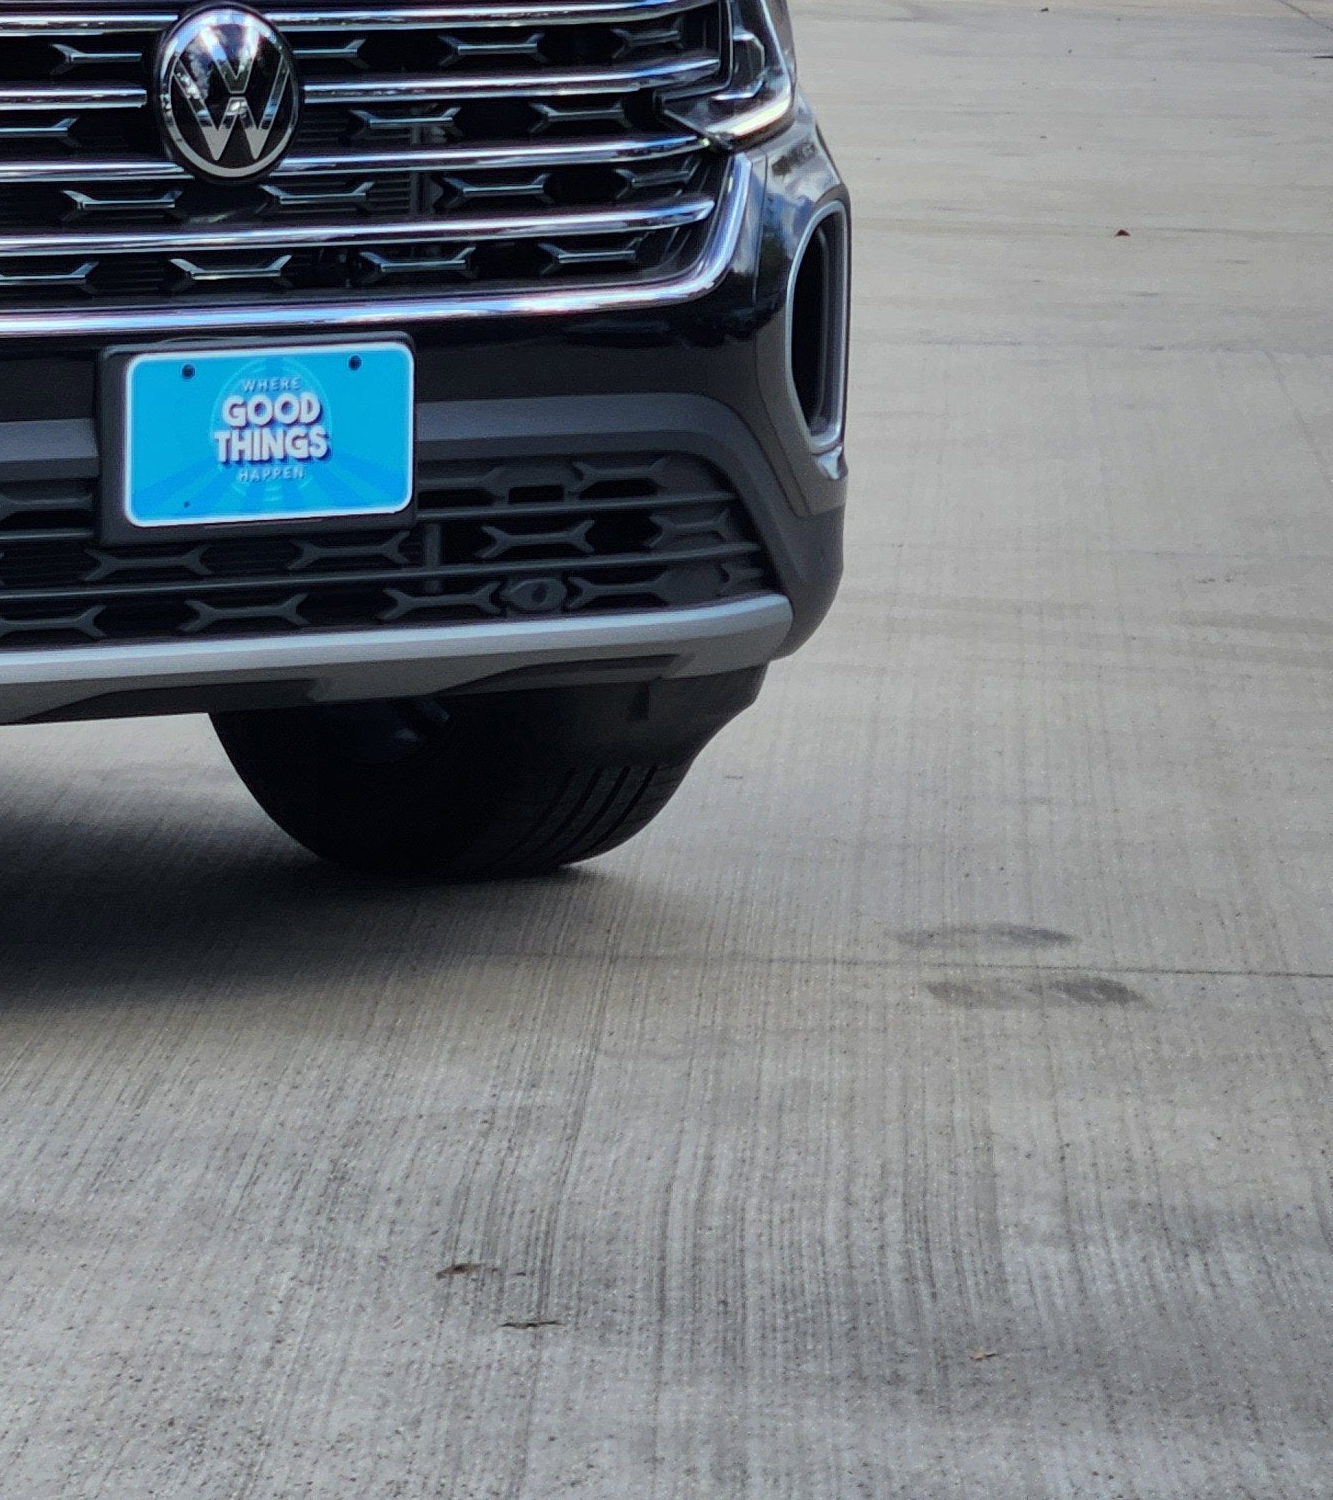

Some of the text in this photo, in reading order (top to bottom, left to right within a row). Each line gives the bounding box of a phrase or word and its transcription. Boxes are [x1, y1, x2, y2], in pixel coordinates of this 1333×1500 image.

[243, 378, 301, 392] WHERE
[222, 391, 323, 428] GOOD
[214, 427, 330, 465] THINGS
[239, 467, 304, 482] HAPPEN
